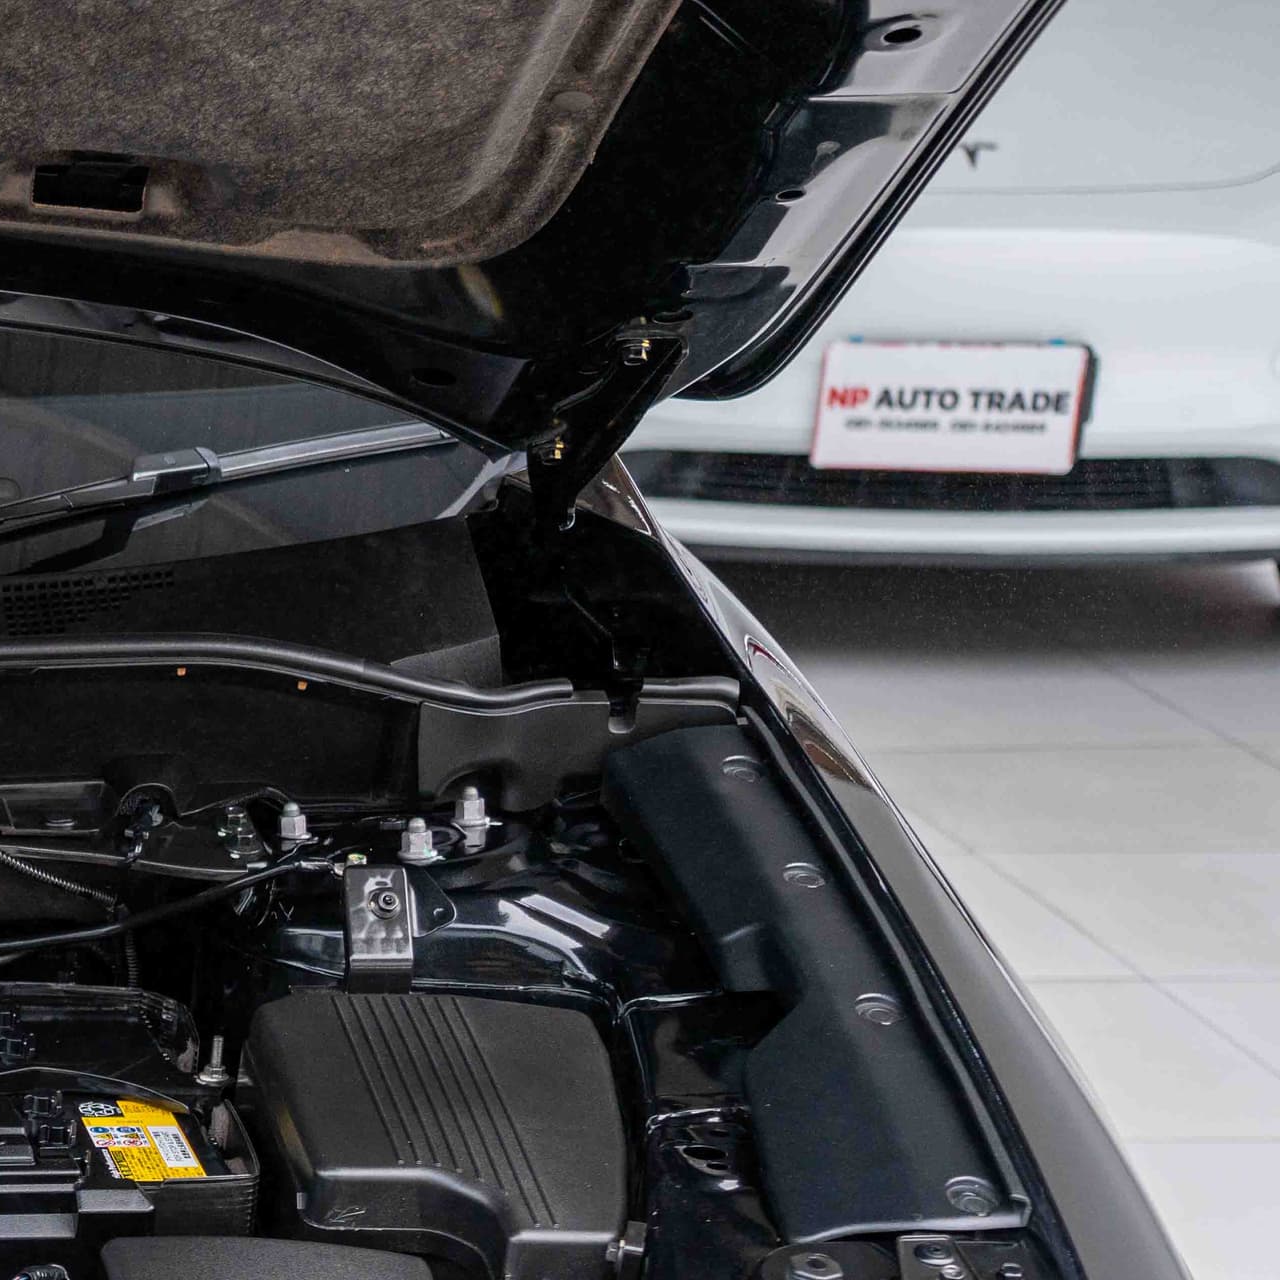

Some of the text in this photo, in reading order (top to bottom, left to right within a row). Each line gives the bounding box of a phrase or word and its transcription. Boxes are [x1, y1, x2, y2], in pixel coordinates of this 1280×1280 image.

[828, 386, 1070, 413] NP AUTO TRADE
